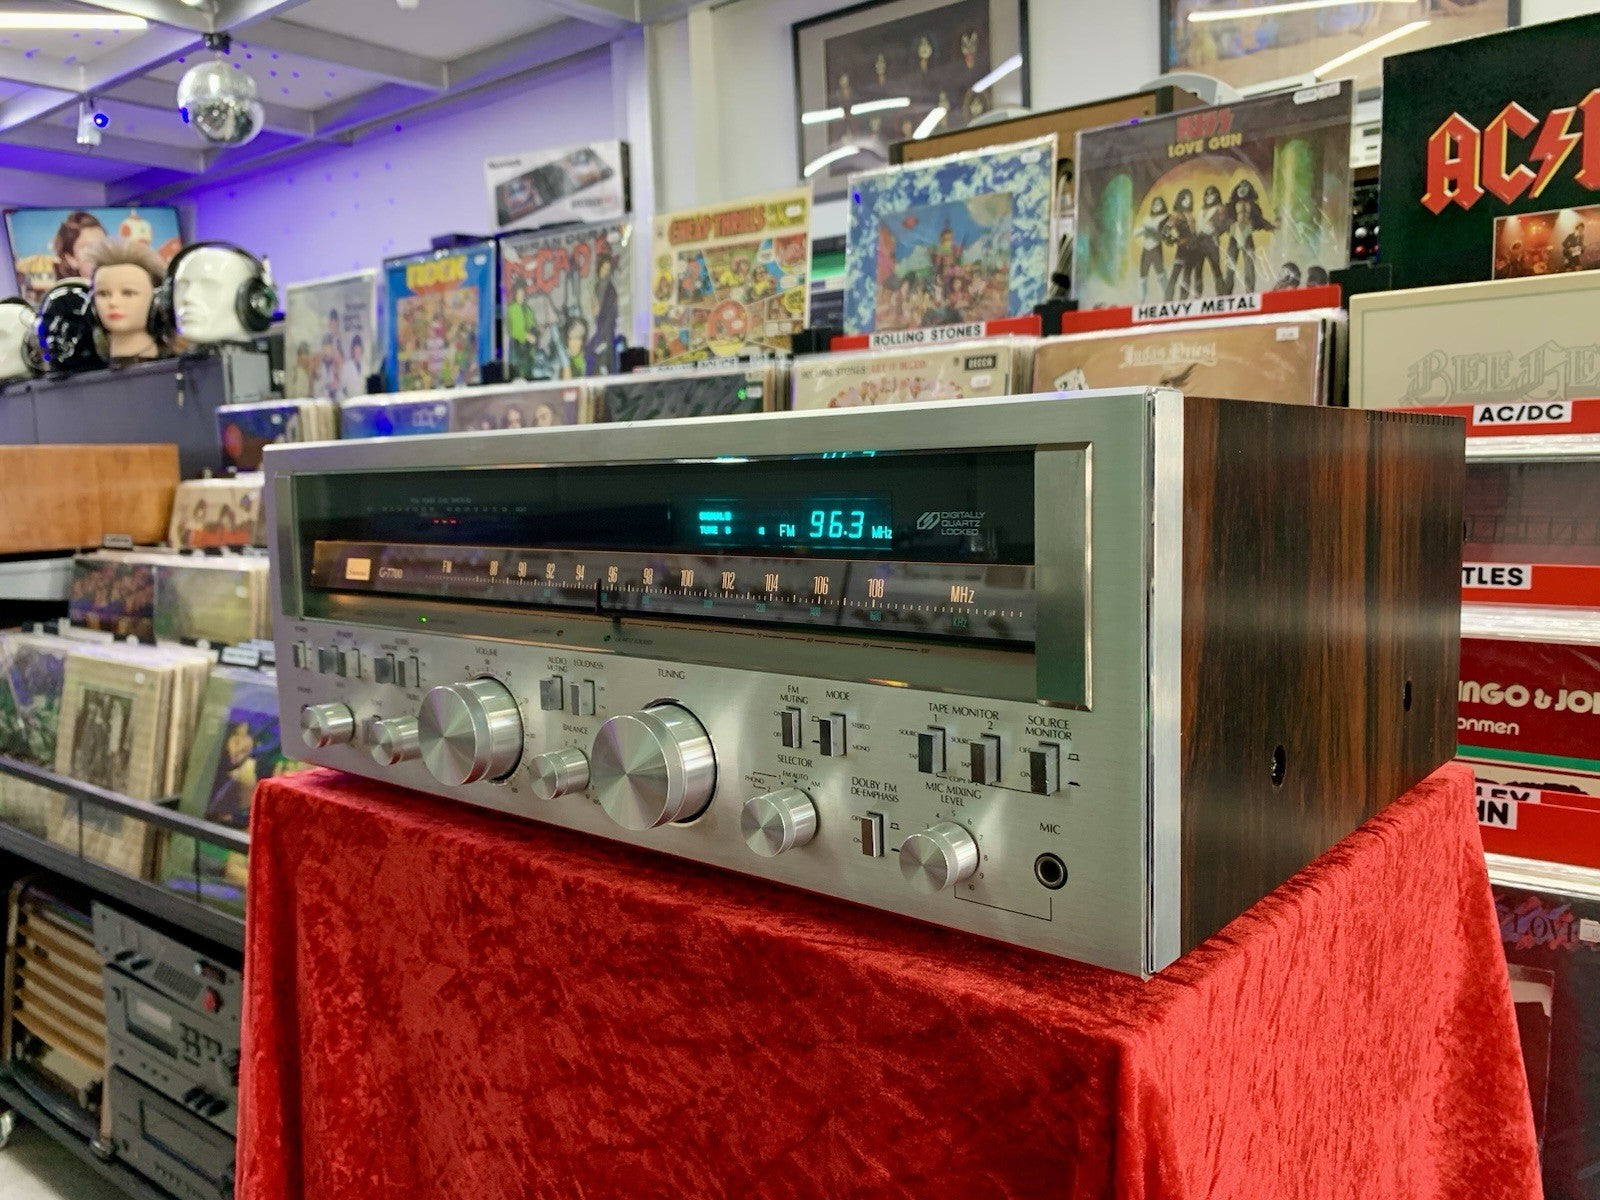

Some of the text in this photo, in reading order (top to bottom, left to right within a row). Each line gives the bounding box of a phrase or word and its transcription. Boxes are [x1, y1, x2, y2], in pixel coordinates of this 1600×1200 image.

[1168, 132, 1243, 158] LOVE GUN
[1137, 295, 1257, 319] HEAVY METAL
[873, 324, 982, 347] ROLLING STONES
[1479, 404, 1564, 423] AC/DC
[941, 511, 985, 519] DIGITALLY
[779, 523, 795, 537] FM
[810, 510, 865, 538] 96.3
[941, 519, 980, 527] QUARTZ
[871, 525, 893, 539] MHz
[941, 528, 979, 536] LOCKED
[545, 563, 556, 579] 92
[575, 564, 585, 581] 94
[607, 565, 618, 583] 96
[642, 567, 654, 585] 98
[680, 569, 694, 587] 100
[721, 571, 735, 590] 102
[764, 573, 778, 592] 104
[813, 575, 829, 595] 106
[867, 578, 884, 598] 108
[950, 585, 975, 604] MHz
[1462, 567, 1523, 586] TLES
[475, 646, 498, 656] VOLUME
[548, 656, 604, 670] AUDIO LOUDNESS
[657, 668, 686, 680] TUNING
[787, 684, 799, 694] FM
[825, 690, 850, 701] MODE
[780, 694, 809, 705] MUTING
[1533, 688, 1552, 710] &
[928, 702, 999, 720] TAPE MONITOR
[562, 723, 589, 735] BALANCE
[987, 721, 993, 730] 2
[1028, 715, 1070, 730] SOURCE
[1025, 727, 1073, 741] MONITOR
[777, 754, 813, 768] SELECTOR
[745, 774, 764, 784] PHONO
[792, 772, 809, 781] AUTO
[852, 776, 897, 793] DOLBY FM
[925, 781, 982, 800] MIC MIXING
[940, 794, 965, 807] LEVEL
[1039, 822, 1061, 835] MIC
